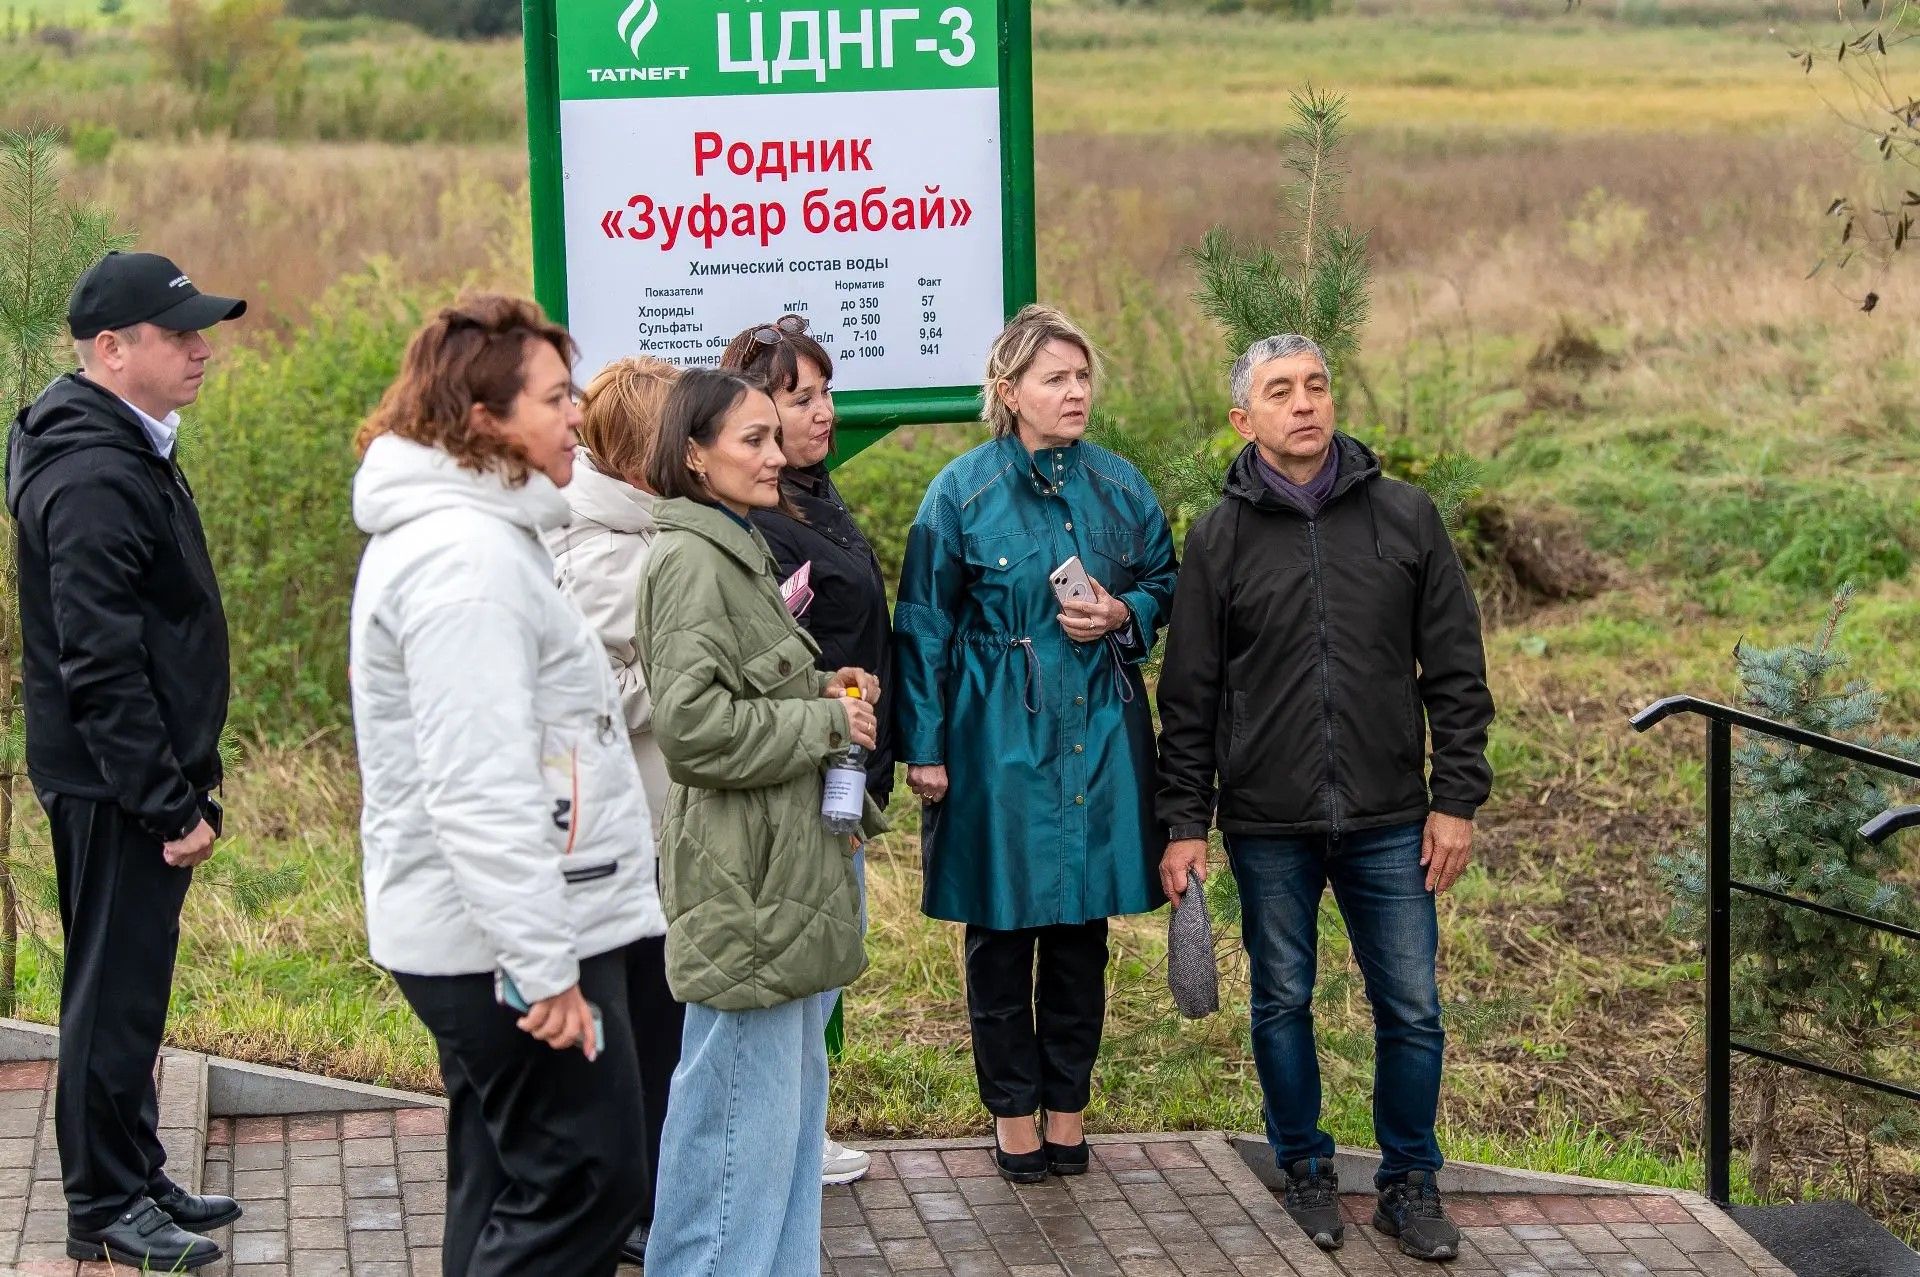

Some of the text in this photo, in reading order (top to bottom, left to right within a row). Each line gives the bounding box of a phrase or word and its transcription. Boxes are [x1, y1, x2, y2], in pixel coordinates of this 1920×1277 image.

[717, 6, 976, 84] ЦДНГ-3
[586, 66, 689, 82] TATNEFT
[693, 131, 873, 182] Родник
[600, 185, 972, 251] «Зуфар бабай»
[689, 257, 889, 276] Химический состав воды
[645, 277, 942, 297] Показатели Норматив Факт
[638, 295, 935, 319] Хлориды мг/л до 350 57
[638, 311, 936, 336] Сульфаты до 500 99
[639, 338, 703, 351] Жесткость
[853, 330, 877, 341] 7-10
[919, 327, 943, 340] 9,64
[840, 350, 855, 360] до
[858, 346, 885, 358] 1000
[920, 344, 939, 355] 941
